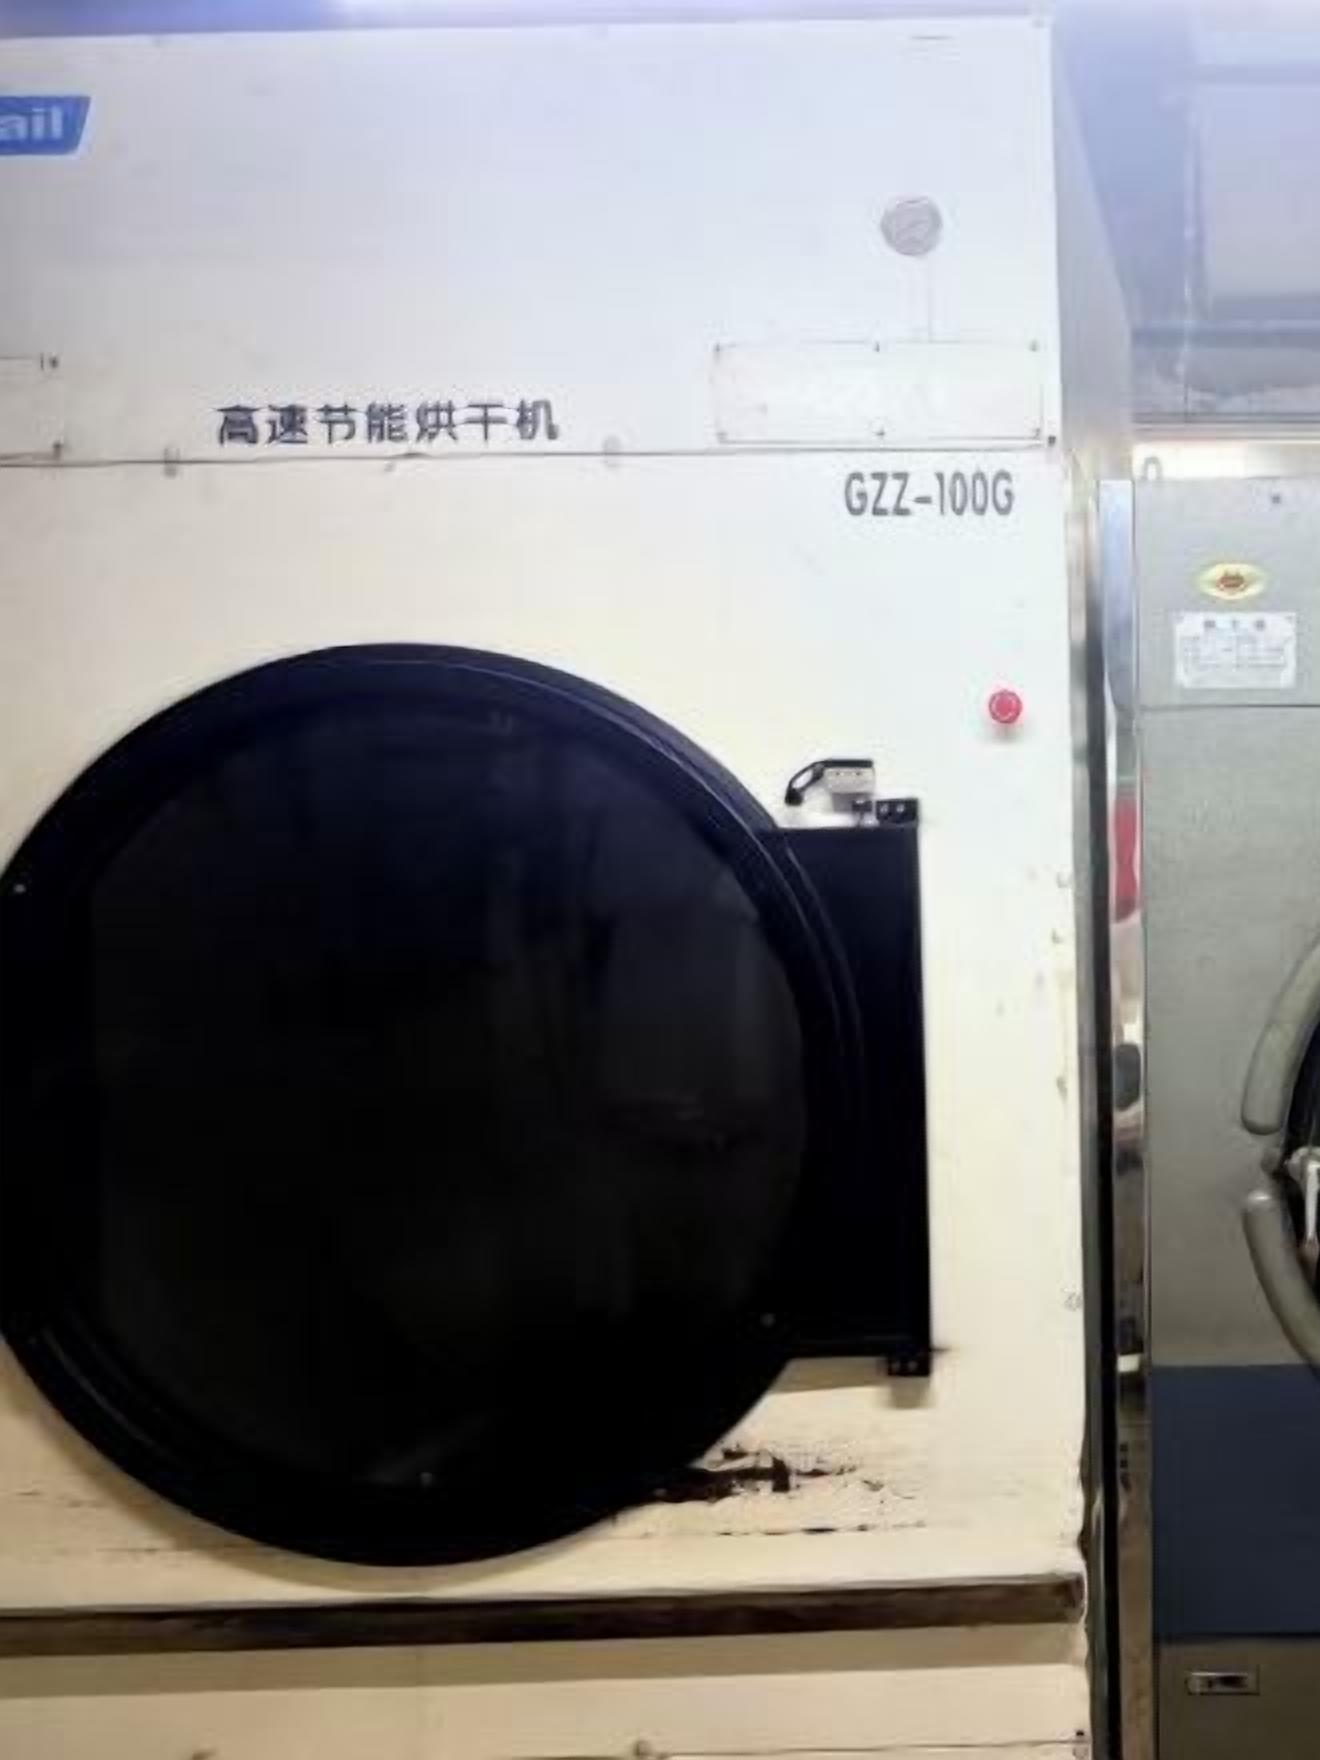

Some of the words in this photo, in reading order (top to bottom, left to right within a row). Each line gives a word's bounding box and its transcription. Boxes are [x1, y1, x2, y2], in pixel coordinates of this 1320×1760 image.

[216, 400, 559, 445] 高速节能烘干机
[844, 471, 1014, 516] GZZ-100G
